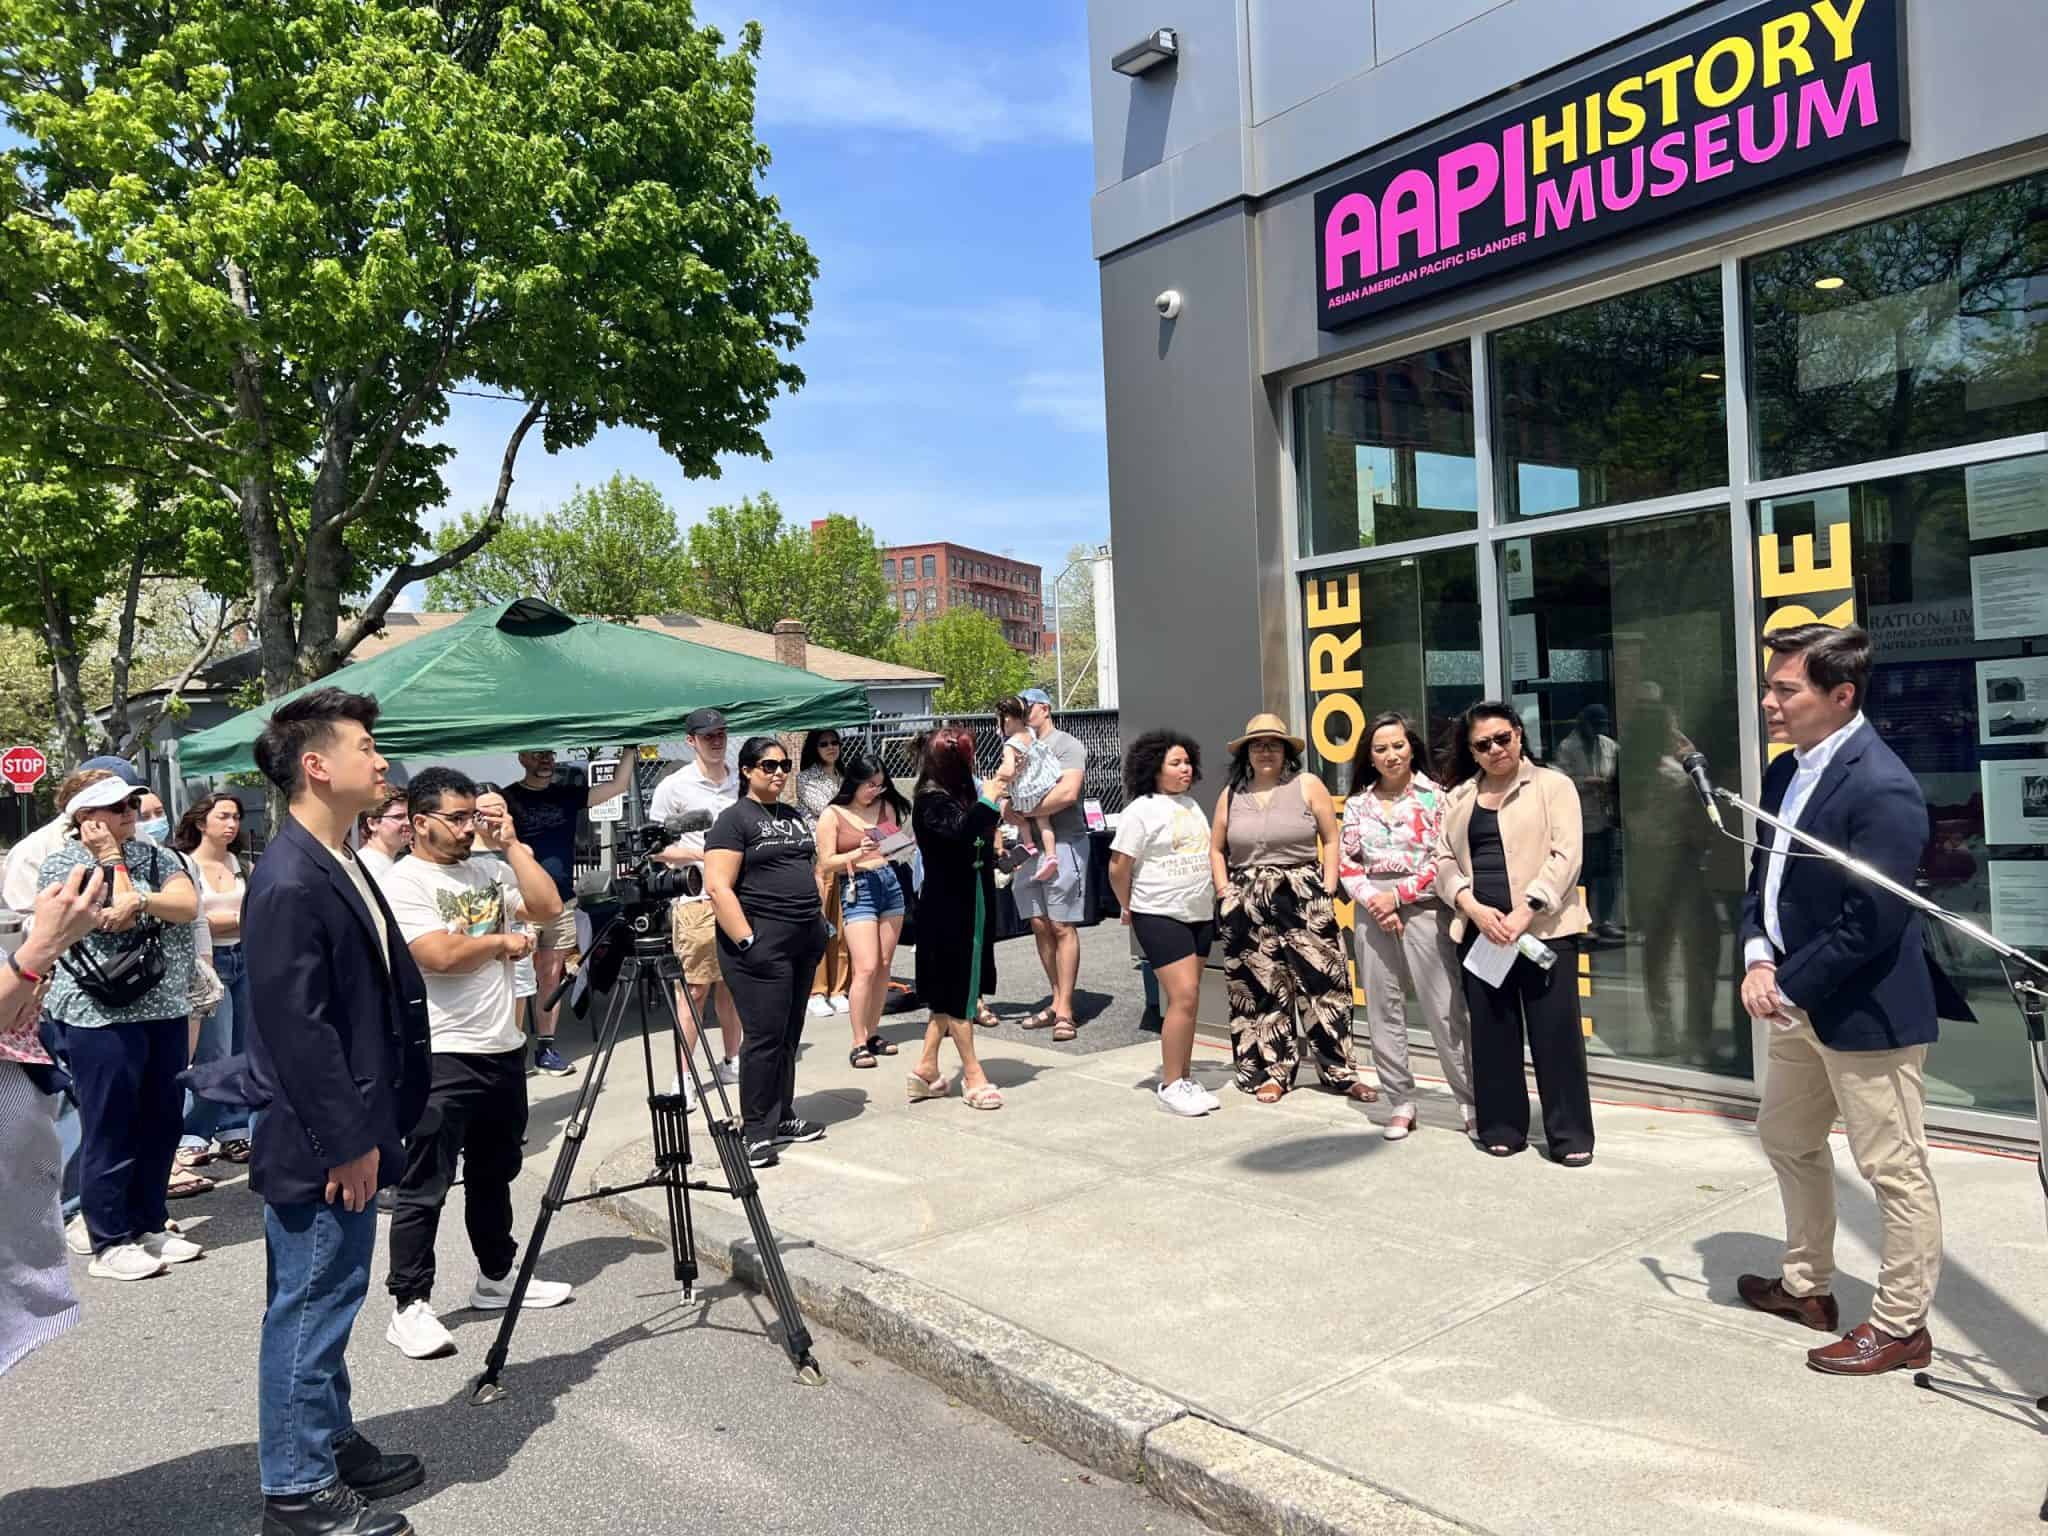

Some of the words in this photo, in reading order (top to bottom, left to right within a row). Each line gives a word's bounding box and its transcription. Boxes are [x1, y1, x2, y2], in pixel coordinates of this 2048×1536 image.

[1325, 124, 1526, 290] AAPI
[1532, 0, 1866, 176] HISTORY
[1533, 62, 1879, 239] MUSEUM
[1328, 289, 1359, 309] ASIAN
[1361, 268, 1418, 298] AMERICAN
[1420, 253, 1465, 279] PACIFIC
[1466, 231, 1528, 262] ISLANDER
[4, 758, 42, 773] STOP
